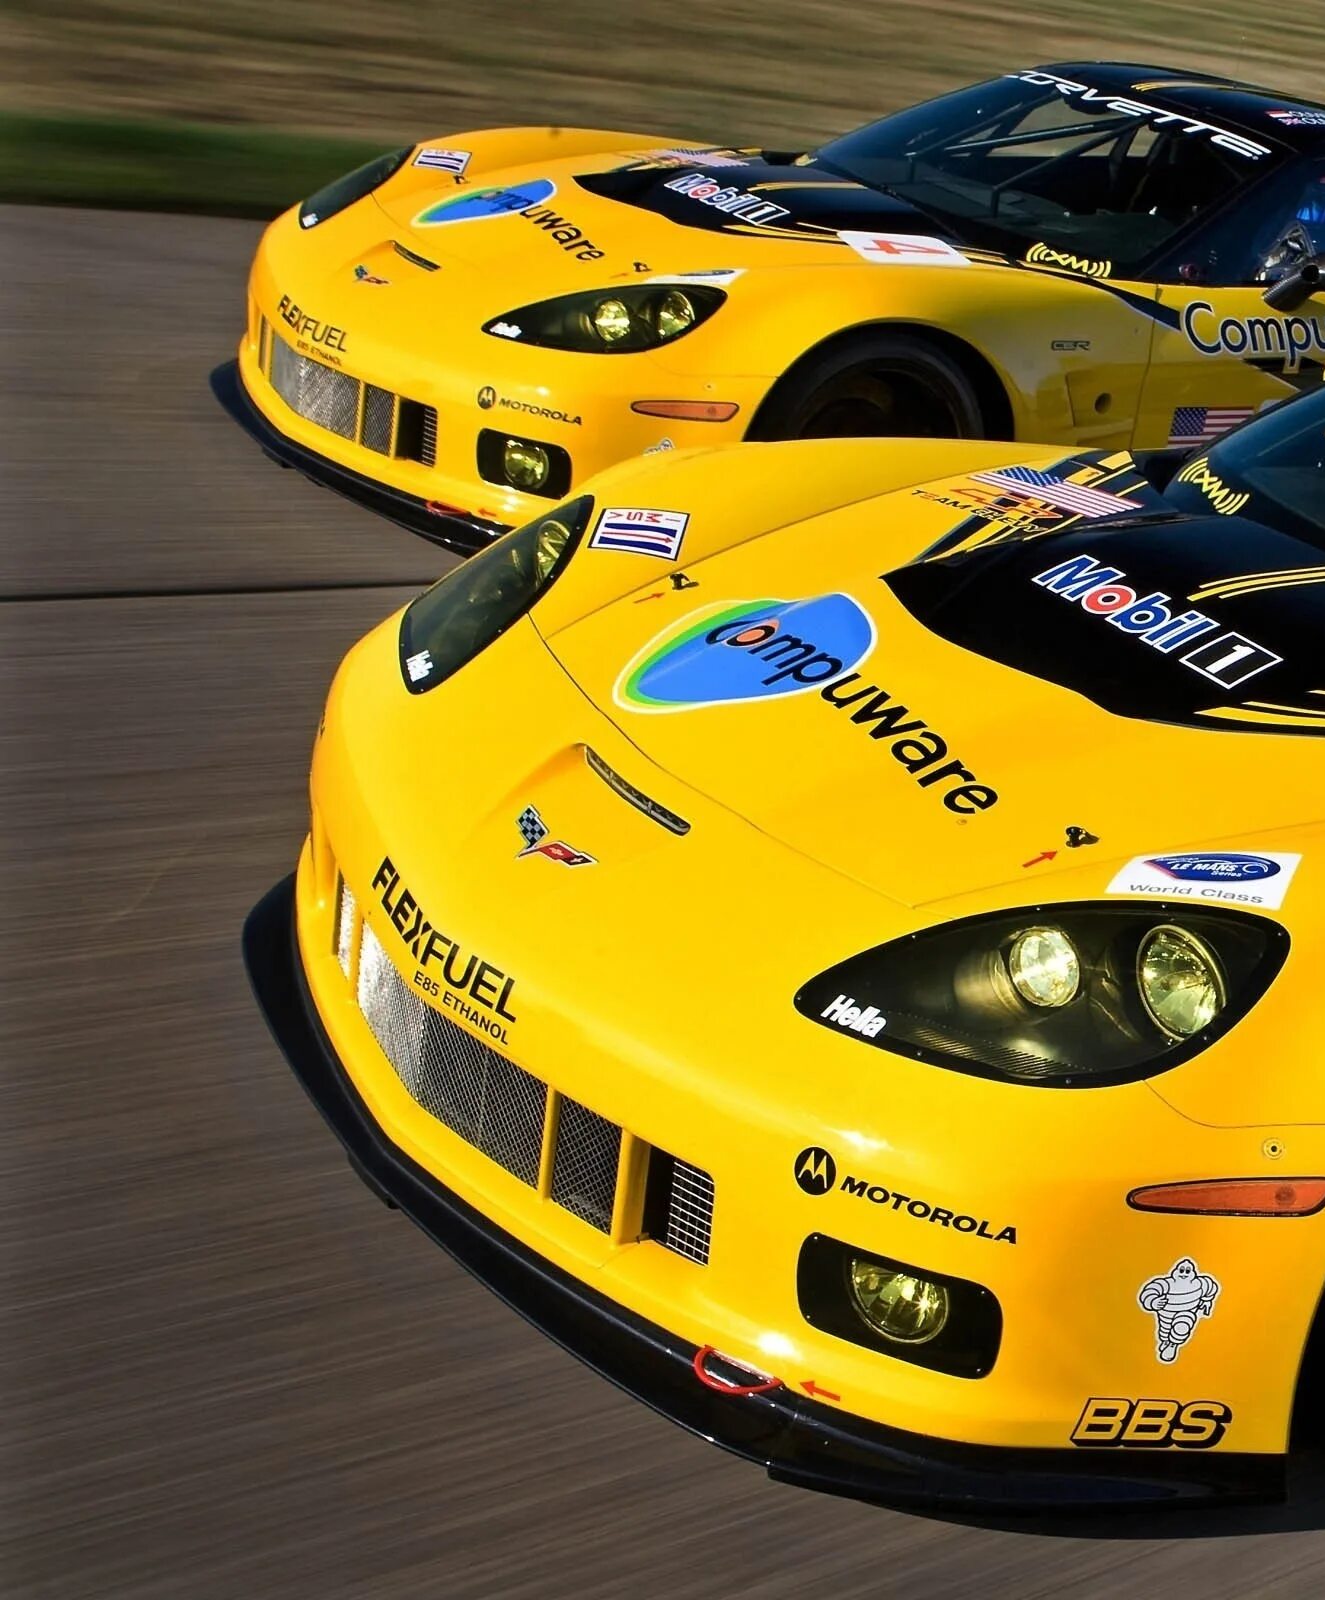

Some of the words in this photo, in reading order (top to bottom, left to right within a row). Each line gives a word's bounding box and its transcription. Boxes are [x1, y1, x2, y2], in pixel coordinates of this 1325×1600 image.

[1004, 70, 1271, 157] CORVETTE
[664, 173, 762, 214] Mobil
[863, 239, 950, 255] 4
[277, 294, 348, 352] FLEXFUEL
[499, 398, 583, 425] MOTOROLA
[911, 489, 973, 510] TEAM
[1031, 554, 1221, 654] Mobil
[1170, 862, 1191, 871] LE
[1192, 862, 1240, 873] MANS
[1129, 883, 1193, 896] World
[1200, 887, 1264, 904] Class
[372, 856, 517, 1024] FLEXFUEL
[413, 970, 440, 997] E85
[442, 990, 509, 1046] ETHANOL
[820, 994, 888, 1038] Hella
[839, 1175, 1018, 1245] MOTOROLA
[1069, 1397, 1233, 1449] BBS
